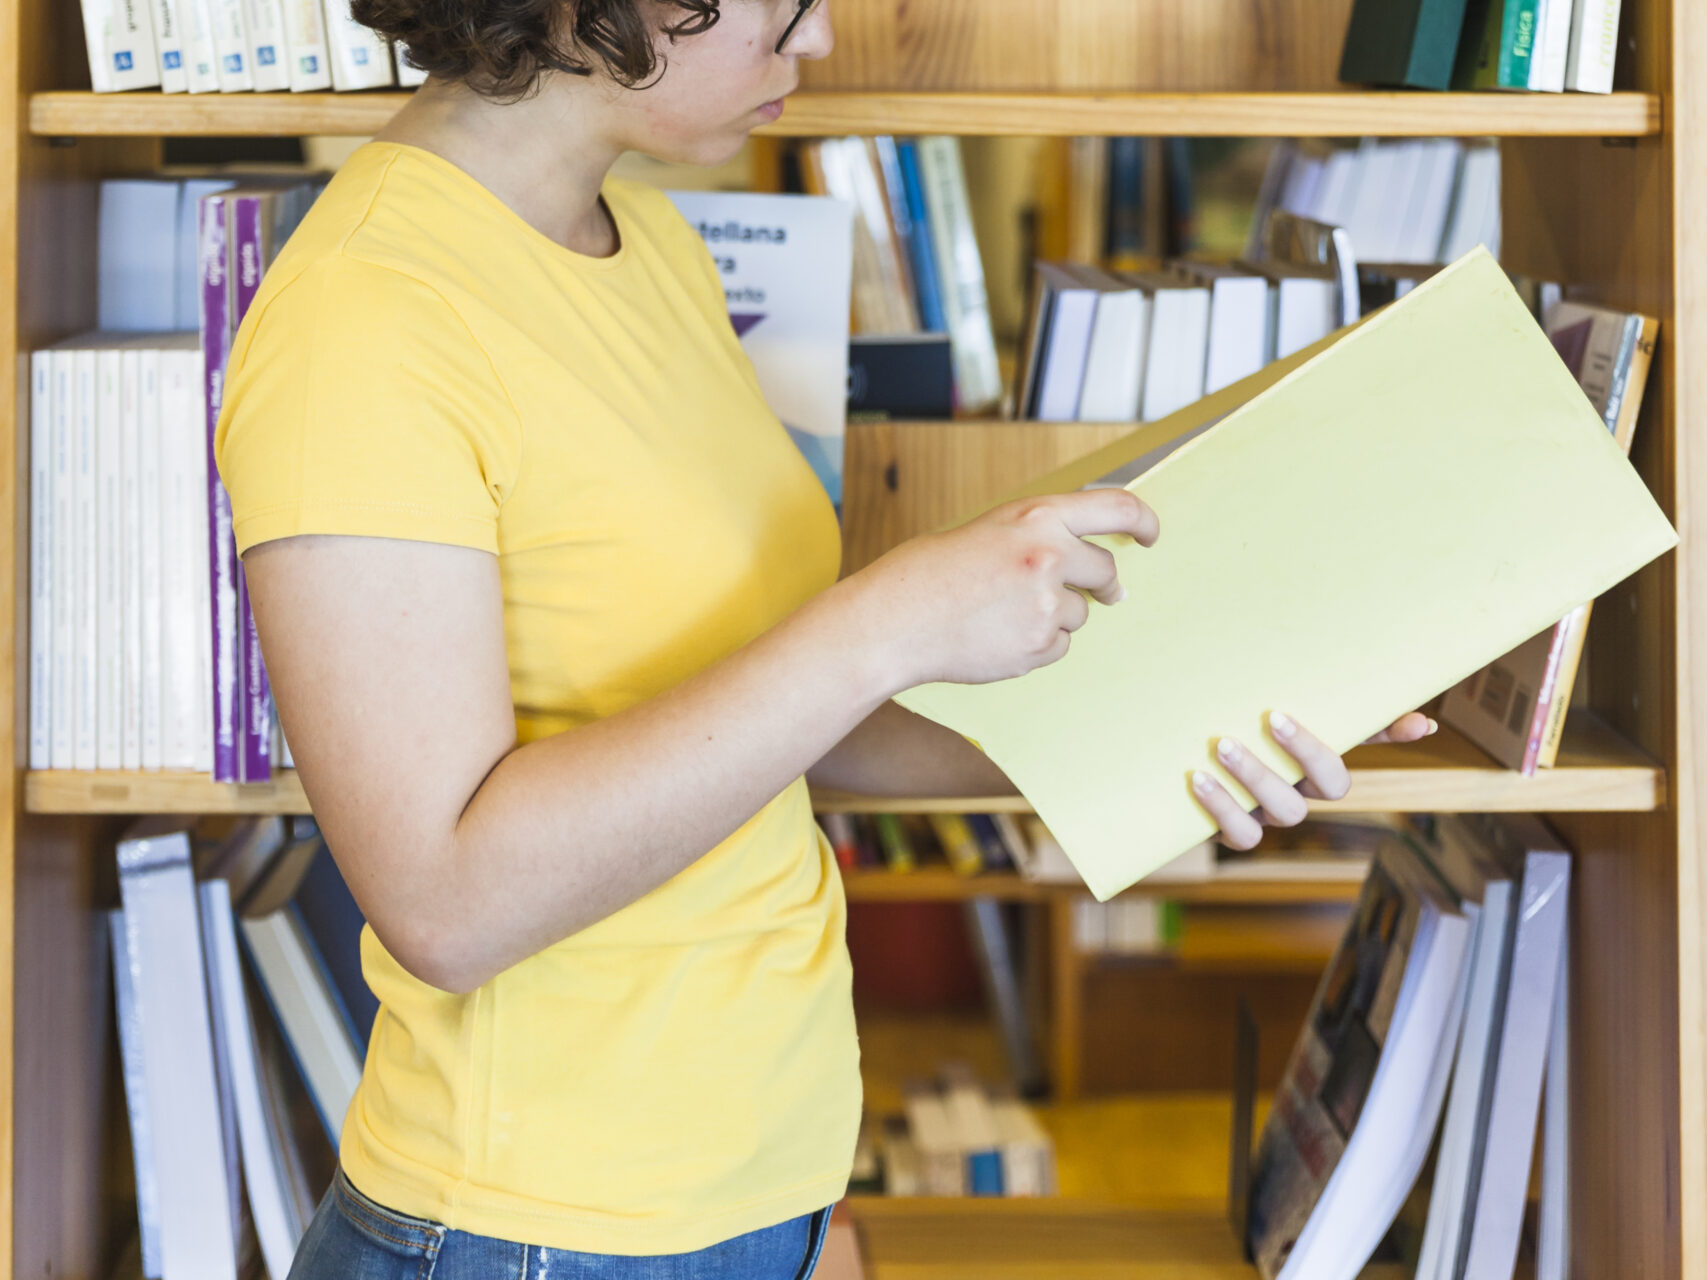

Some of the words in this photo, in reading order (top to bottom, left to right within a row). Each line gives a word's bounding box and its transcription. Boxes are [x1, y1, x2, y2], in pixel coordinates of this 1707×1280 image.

[1513, 8, 1532, 57] Física
[238, 242, 258, 287] algaida
[251, 696, 263, 734] Lengua
